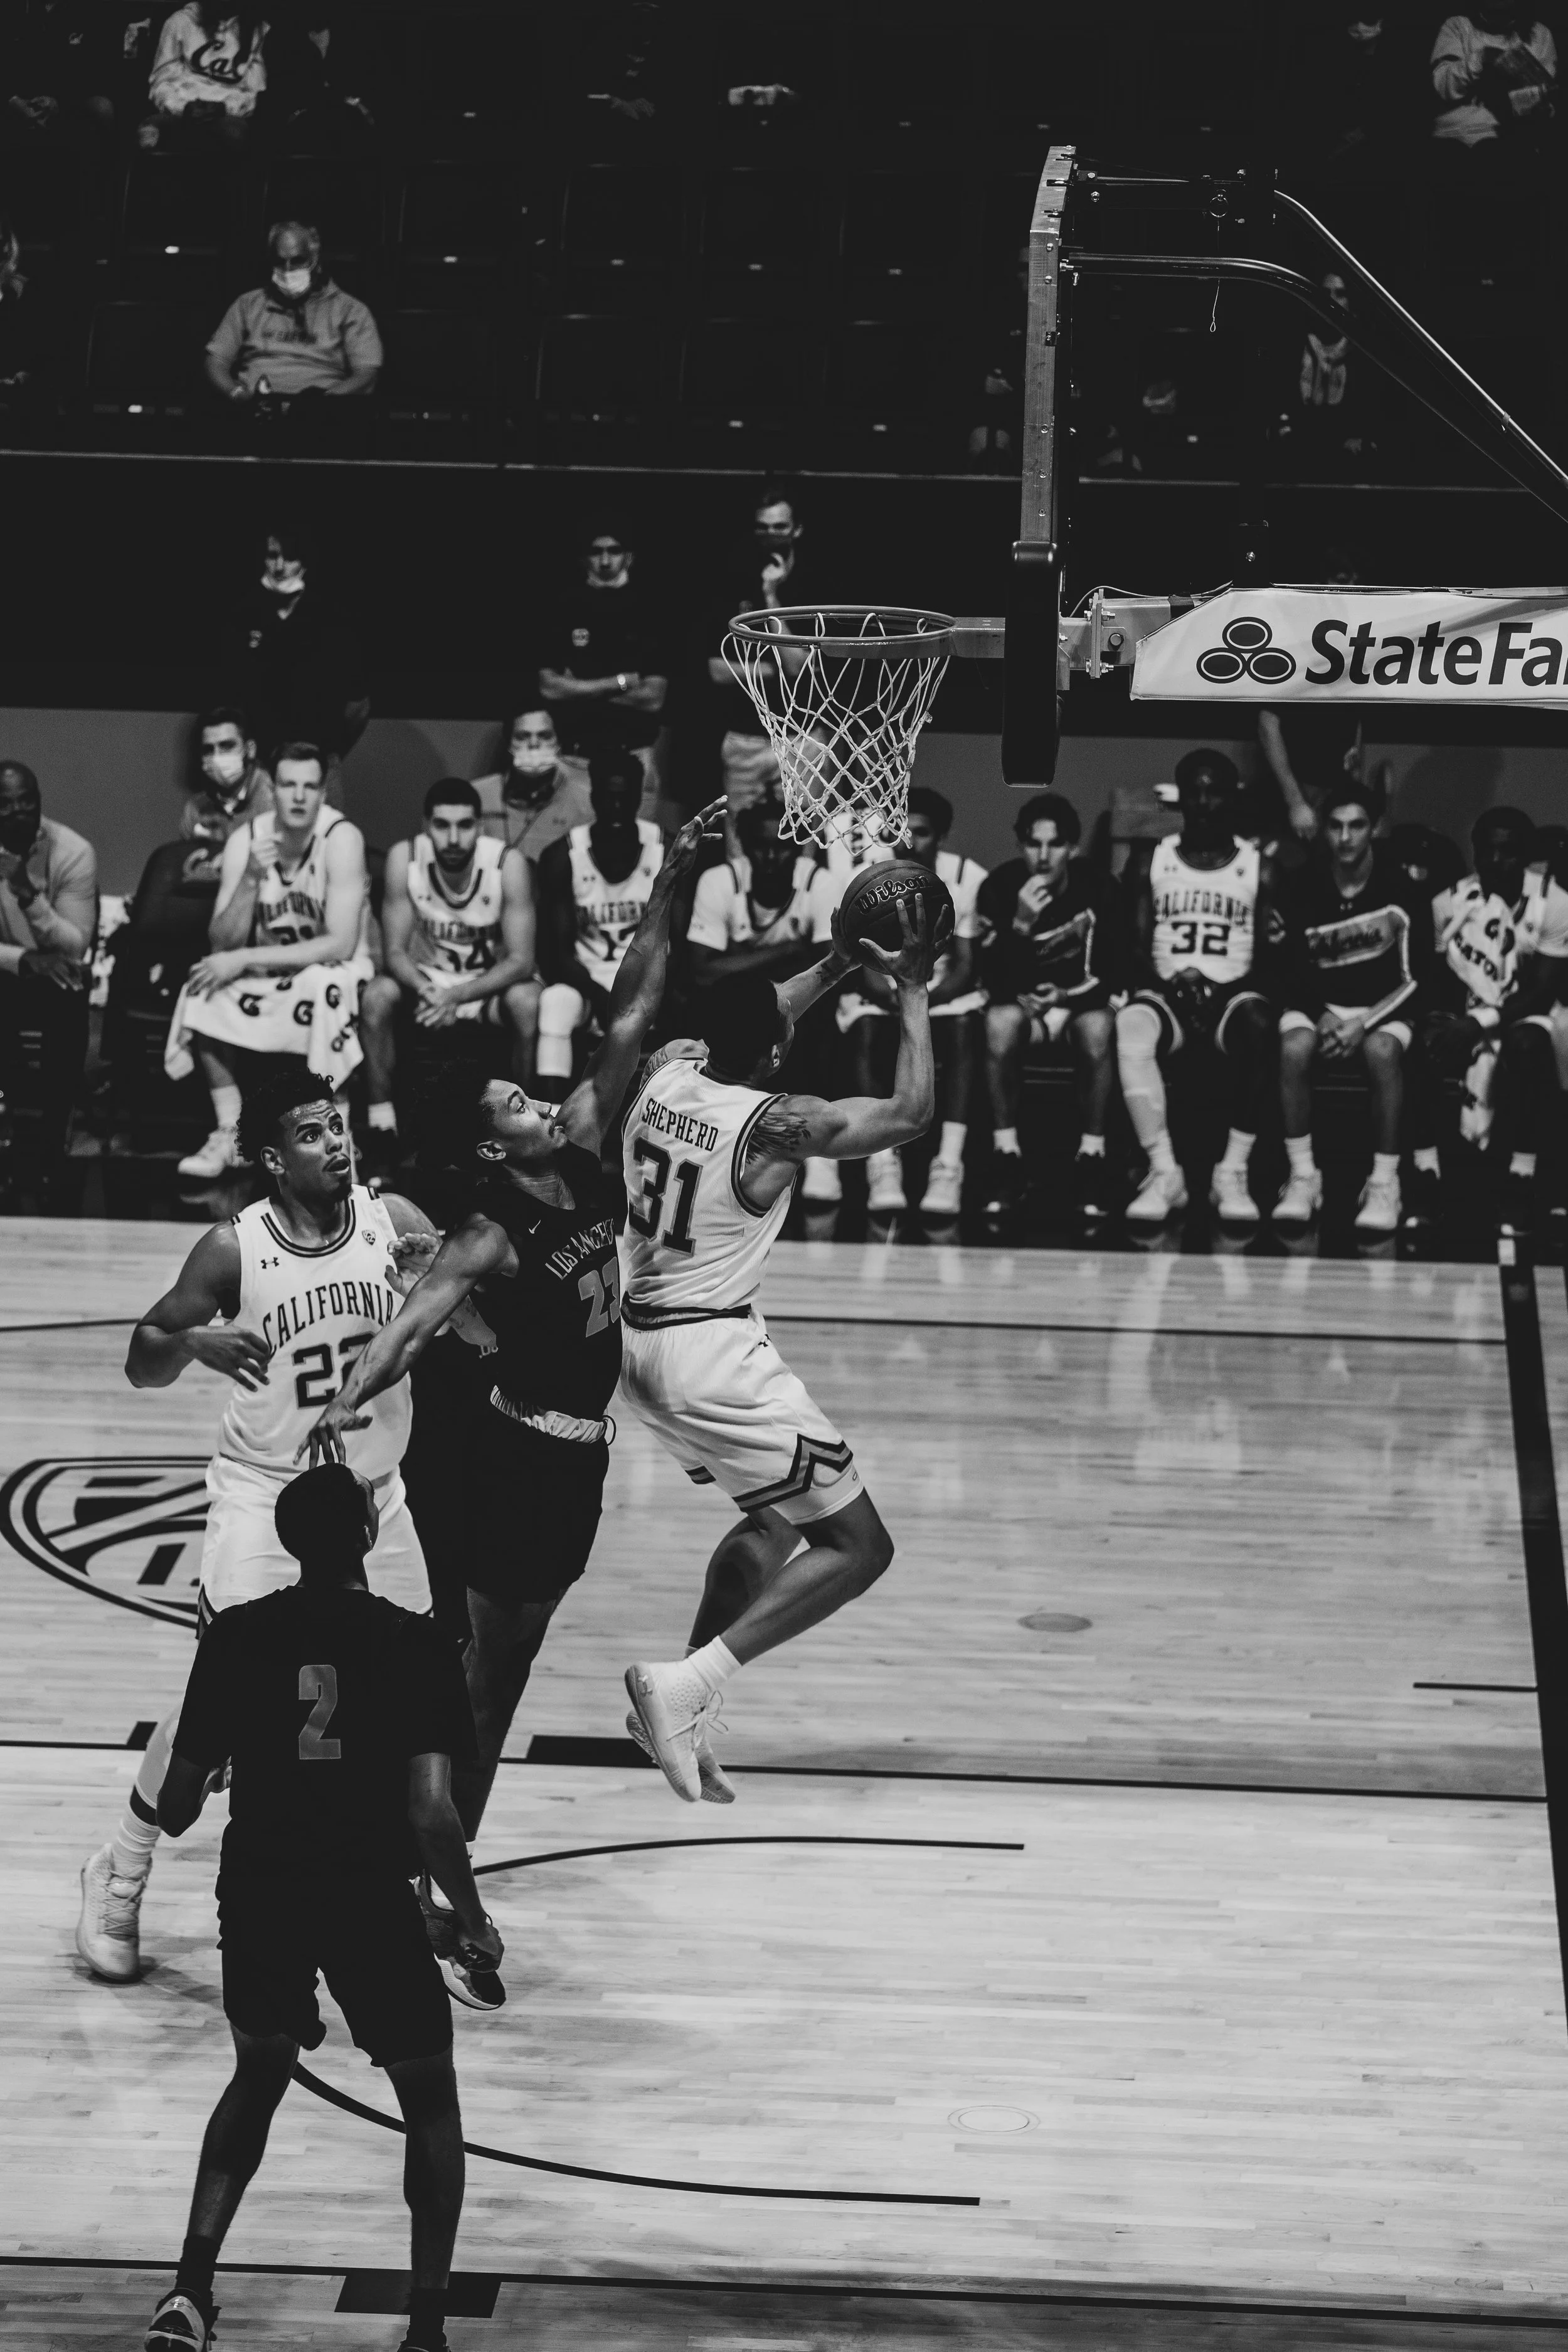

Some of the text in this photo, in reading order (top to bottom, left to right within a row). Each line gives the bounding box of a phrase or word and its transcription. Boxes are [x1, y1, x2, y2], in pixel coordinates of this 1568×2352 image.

[191, 39, 243, 85] Cal
[1488, 622, 1568, 687] Fa
[854, 876, 930, 915] Wilson
[1171, 921, 1231, 956] 32
[294, 1000, 314, 1025] G
[642, 1098, 719, 1152] SHEPHERD
[628, 1136, 704, 1258] 31
[545, 1244, 578, 1281] LOS
[263, 1281, 394, 1366] CALIFORNIA
[298, 1664, 342, 1760] 2
